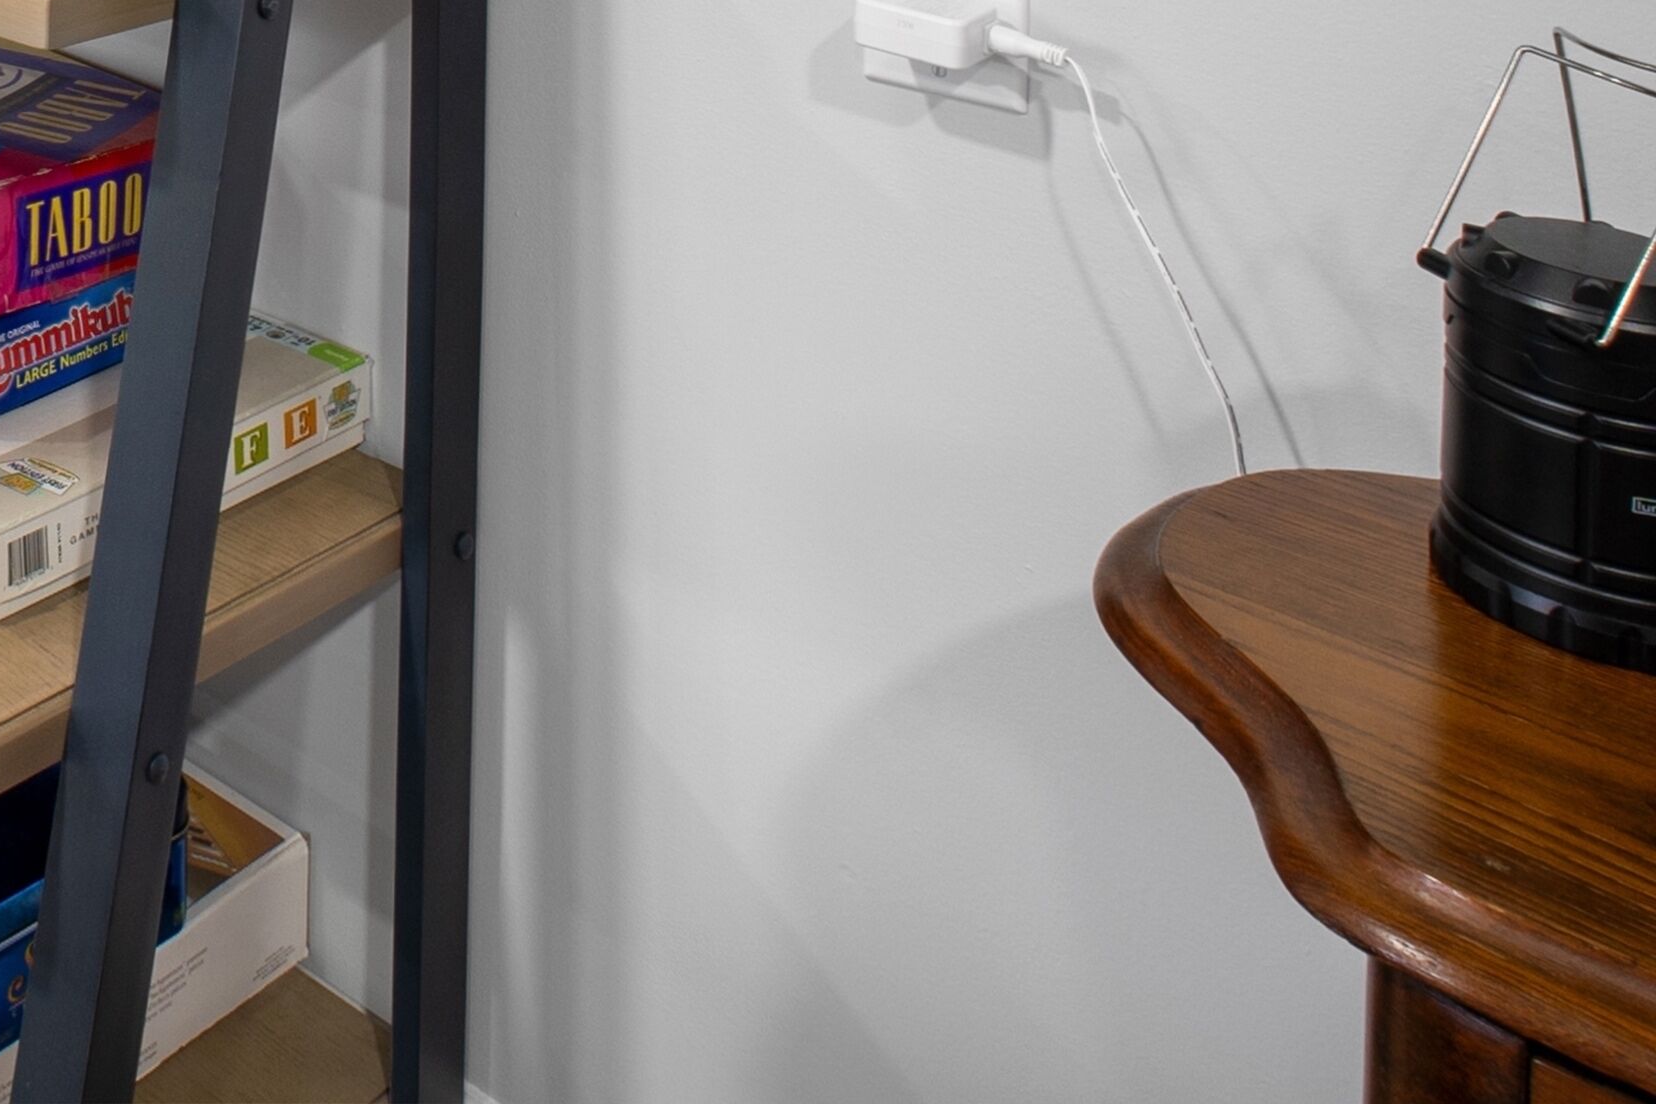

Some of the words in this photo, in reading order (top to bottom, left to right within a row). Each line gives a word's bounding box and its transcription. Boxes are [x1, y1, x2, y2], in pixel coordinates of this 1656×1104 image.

[25, 172, 143, 267] TABOO
[6, 319, 40, 339] ORIGINAL
[15, 359, 57, 390] LARGE
[59, 339, 108, 371] Numbers
